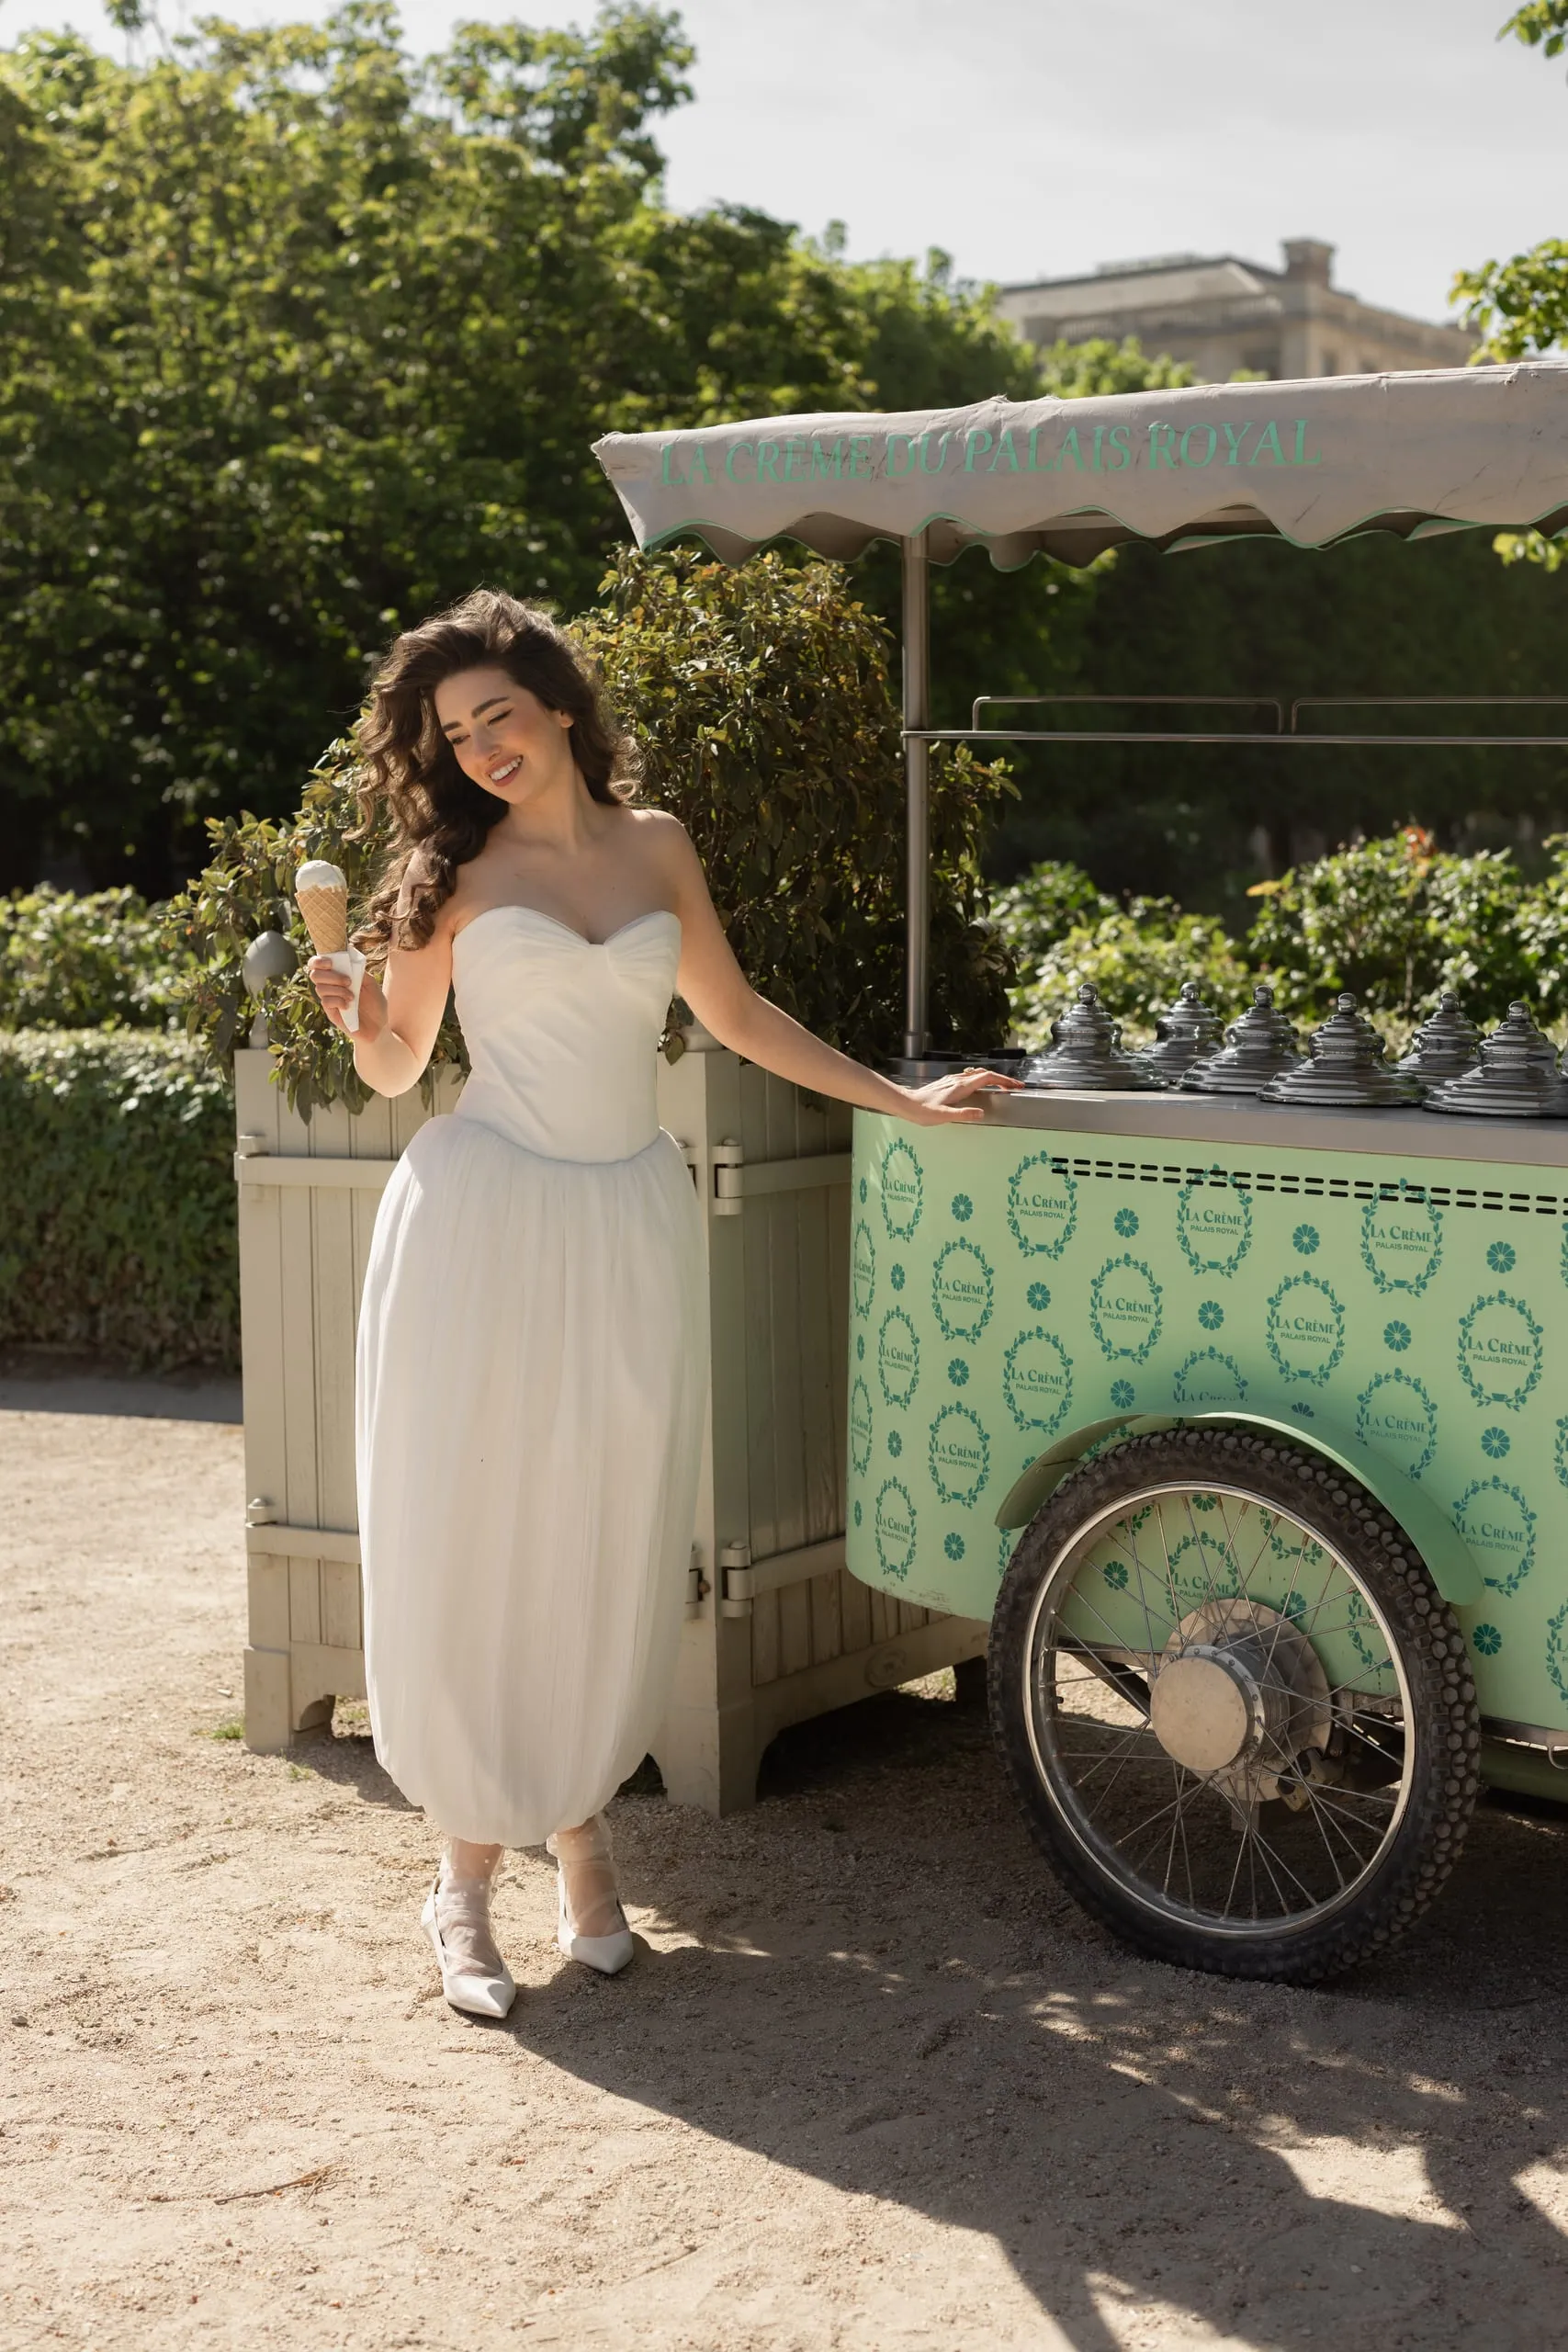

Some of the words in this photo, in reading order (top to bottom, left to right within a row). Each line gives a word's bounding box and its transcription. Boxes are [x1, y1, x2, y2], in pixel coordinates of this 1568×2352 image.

[661, 444, 715, 485] LA
[724, 434, 874, 485] CRÈME
[885, 431, 953, 478] DU
[962, 424, 1132, 473] PALAIS
[1146, 418, 1323, 470] ROYAL
[1016, 1193, 1029, 1206] LA
[1032, 1194, 1069, 1210] CRÈME
[1020, 1209, 1043, 1217] PALAIS
[1043, 1211, 1065, 1219] ROYAL
[1186, 1208, 1200, 1222] LA
[1203, 1209, 1242, 1226] CRÈME
[1190, 1225, 1214, 1233] PALAIS
[1371, 1225, 1385, 1238] LA
[1390, 1226, 1432, 1243] CRÈME
[1375, 1241, 1402, 1250] PALAIS
[1403, 1244, 1428, 1252] ROYAL
[939, 1278, 950, 1291] LA
[953, 1279, 986, 1295] CRÈME
[1099, 1295, 1111, 1309] LA
[1115, 1297, 1154, 1314] CRÈME
[1102, 1312, 1127, 1320] PALAIS
[1128, 1315, 1150, 1323] ROYAL
[1276, 1316, 1290, 1329] LA
[1293, 1317, 1336, 1334] CRÈME
[1280, 1332, 1306, 1341] PALAIS
[1307, 1335, 1331, 1344] ROYAL
[1468, 1336, 1483, 1351] LA
[1488, 1338, 1532, 1356] CRÈME
[1472, 1354, 1500, 1363] PALAIS
[1501, 1357, 1529, 1366] ROYAL
[1011, 1367, 1024, 1381] LA
[1028, 1369, 1064, 1385] CRÈME
[1016, 1384, 1038, 1392] PALAIS
[1039, 1386, 1061, 1395] ROYAL
[1366, 1412, 1380, 1427] LA
[1384, 1415, 1427, 1433] CRÈME
[935, 1441, 946, 1454] LA
[949, 1443, 982, 1461] CRÈME
[1461, 1520, 1477, 1534] LA
[1481, 1523, 1525, 1543] CRÈME
[1175, 1573, 1188, 1587] LA
[1192, 1577, 1231, 1594] CRME
